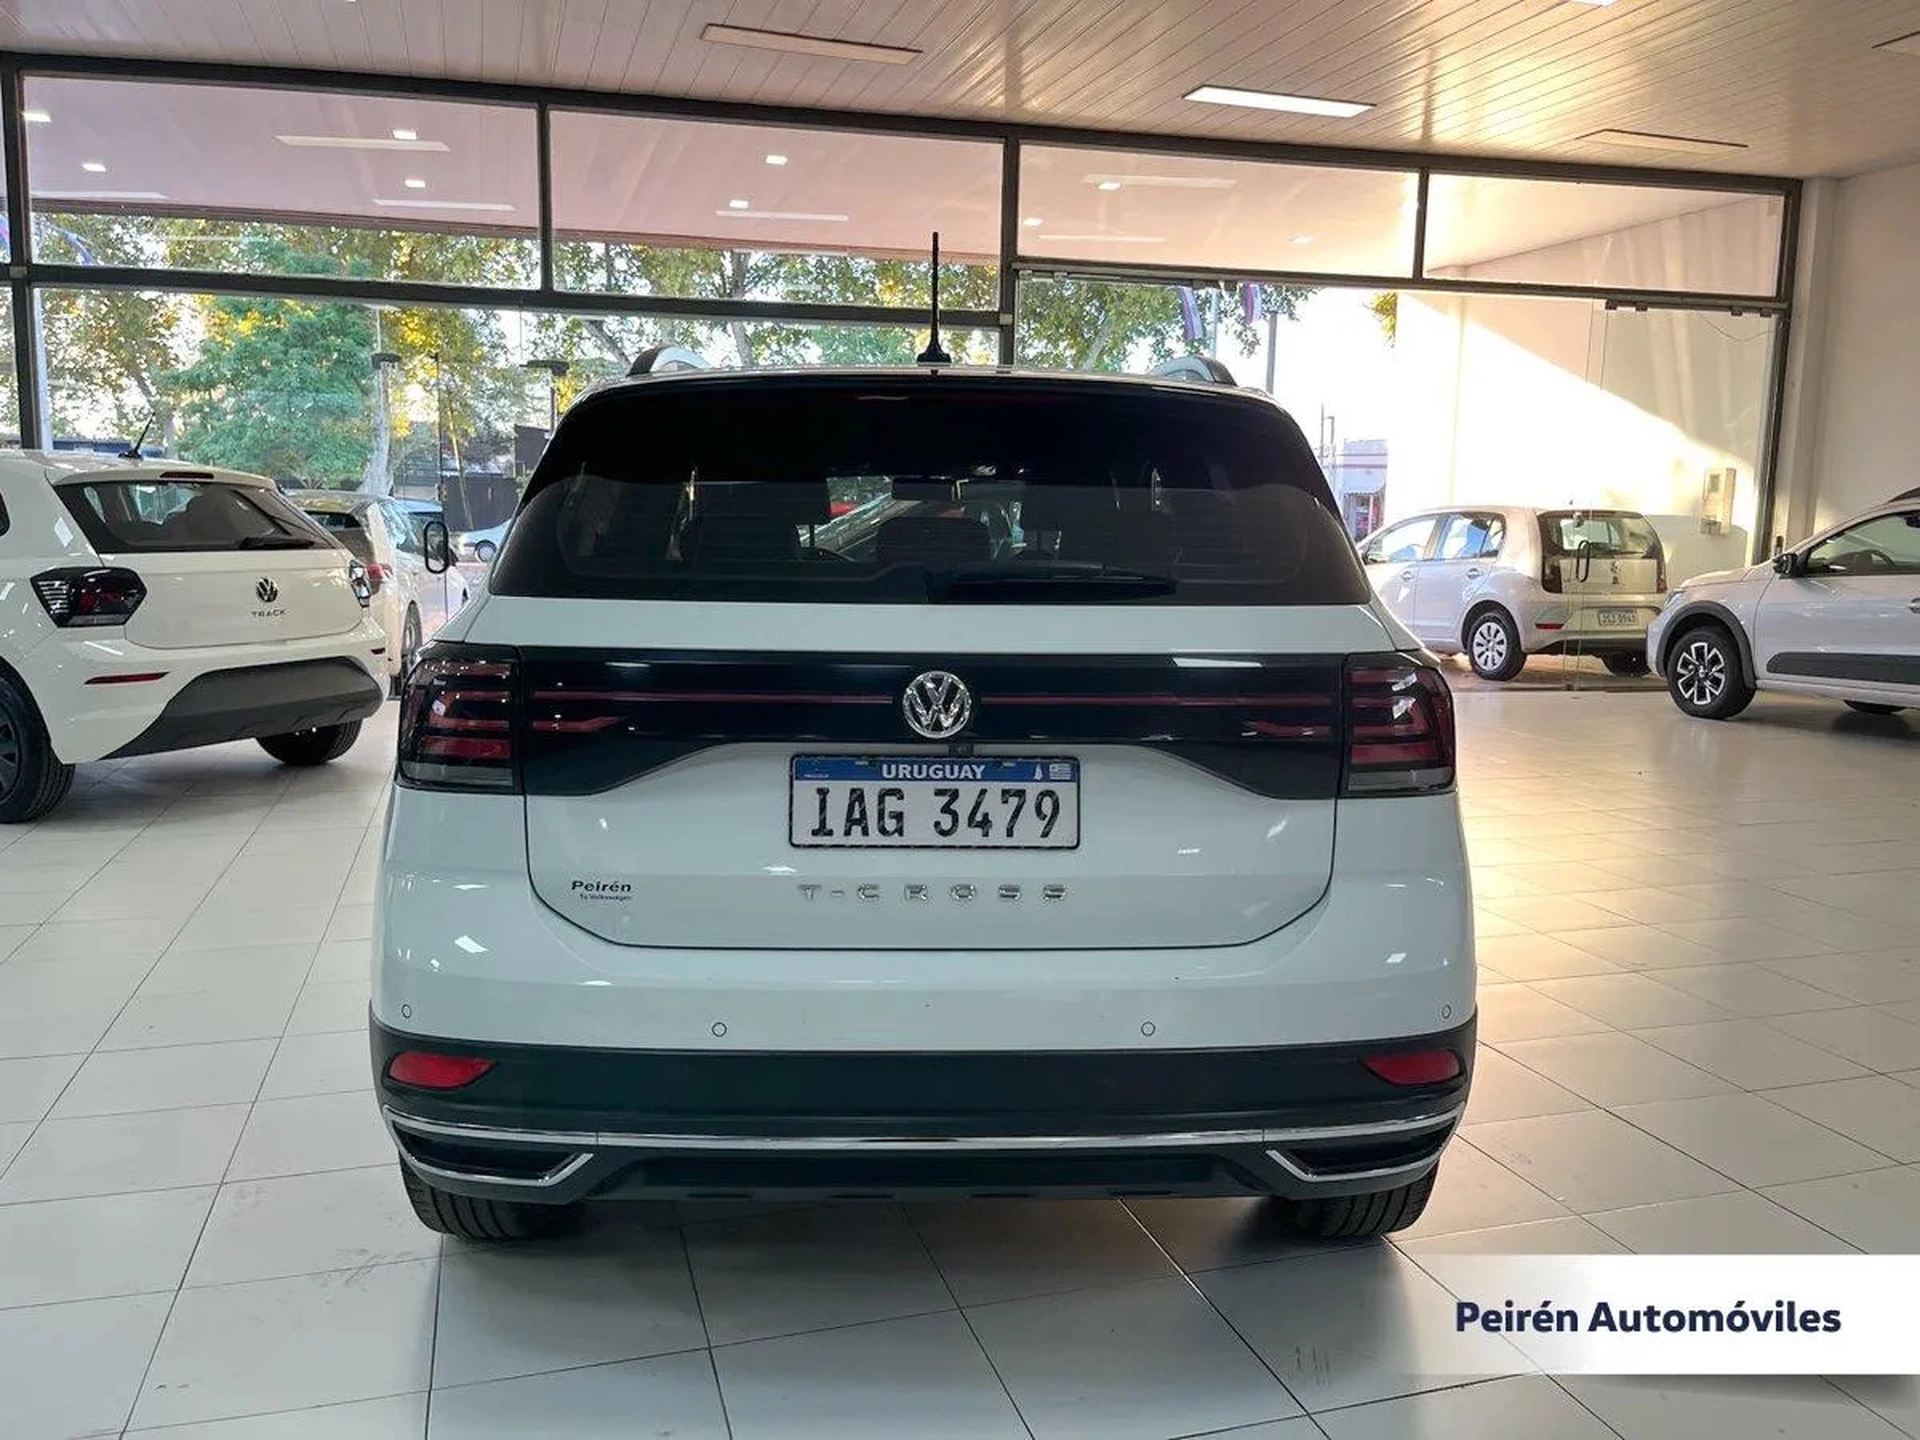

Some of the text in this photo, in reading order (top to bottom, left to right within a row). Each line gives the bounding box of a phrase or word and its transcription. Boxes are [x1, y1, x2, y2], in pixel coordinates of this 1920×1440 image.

[251, 609, 287, 618] TRACK
[881, 763, 986, 780] URUGUAY
[811, 787, 1061, 839] IAG 3479
[571, 880, 632, 893] Peirén
[797, 884, 1068, 901] T-CROSS
